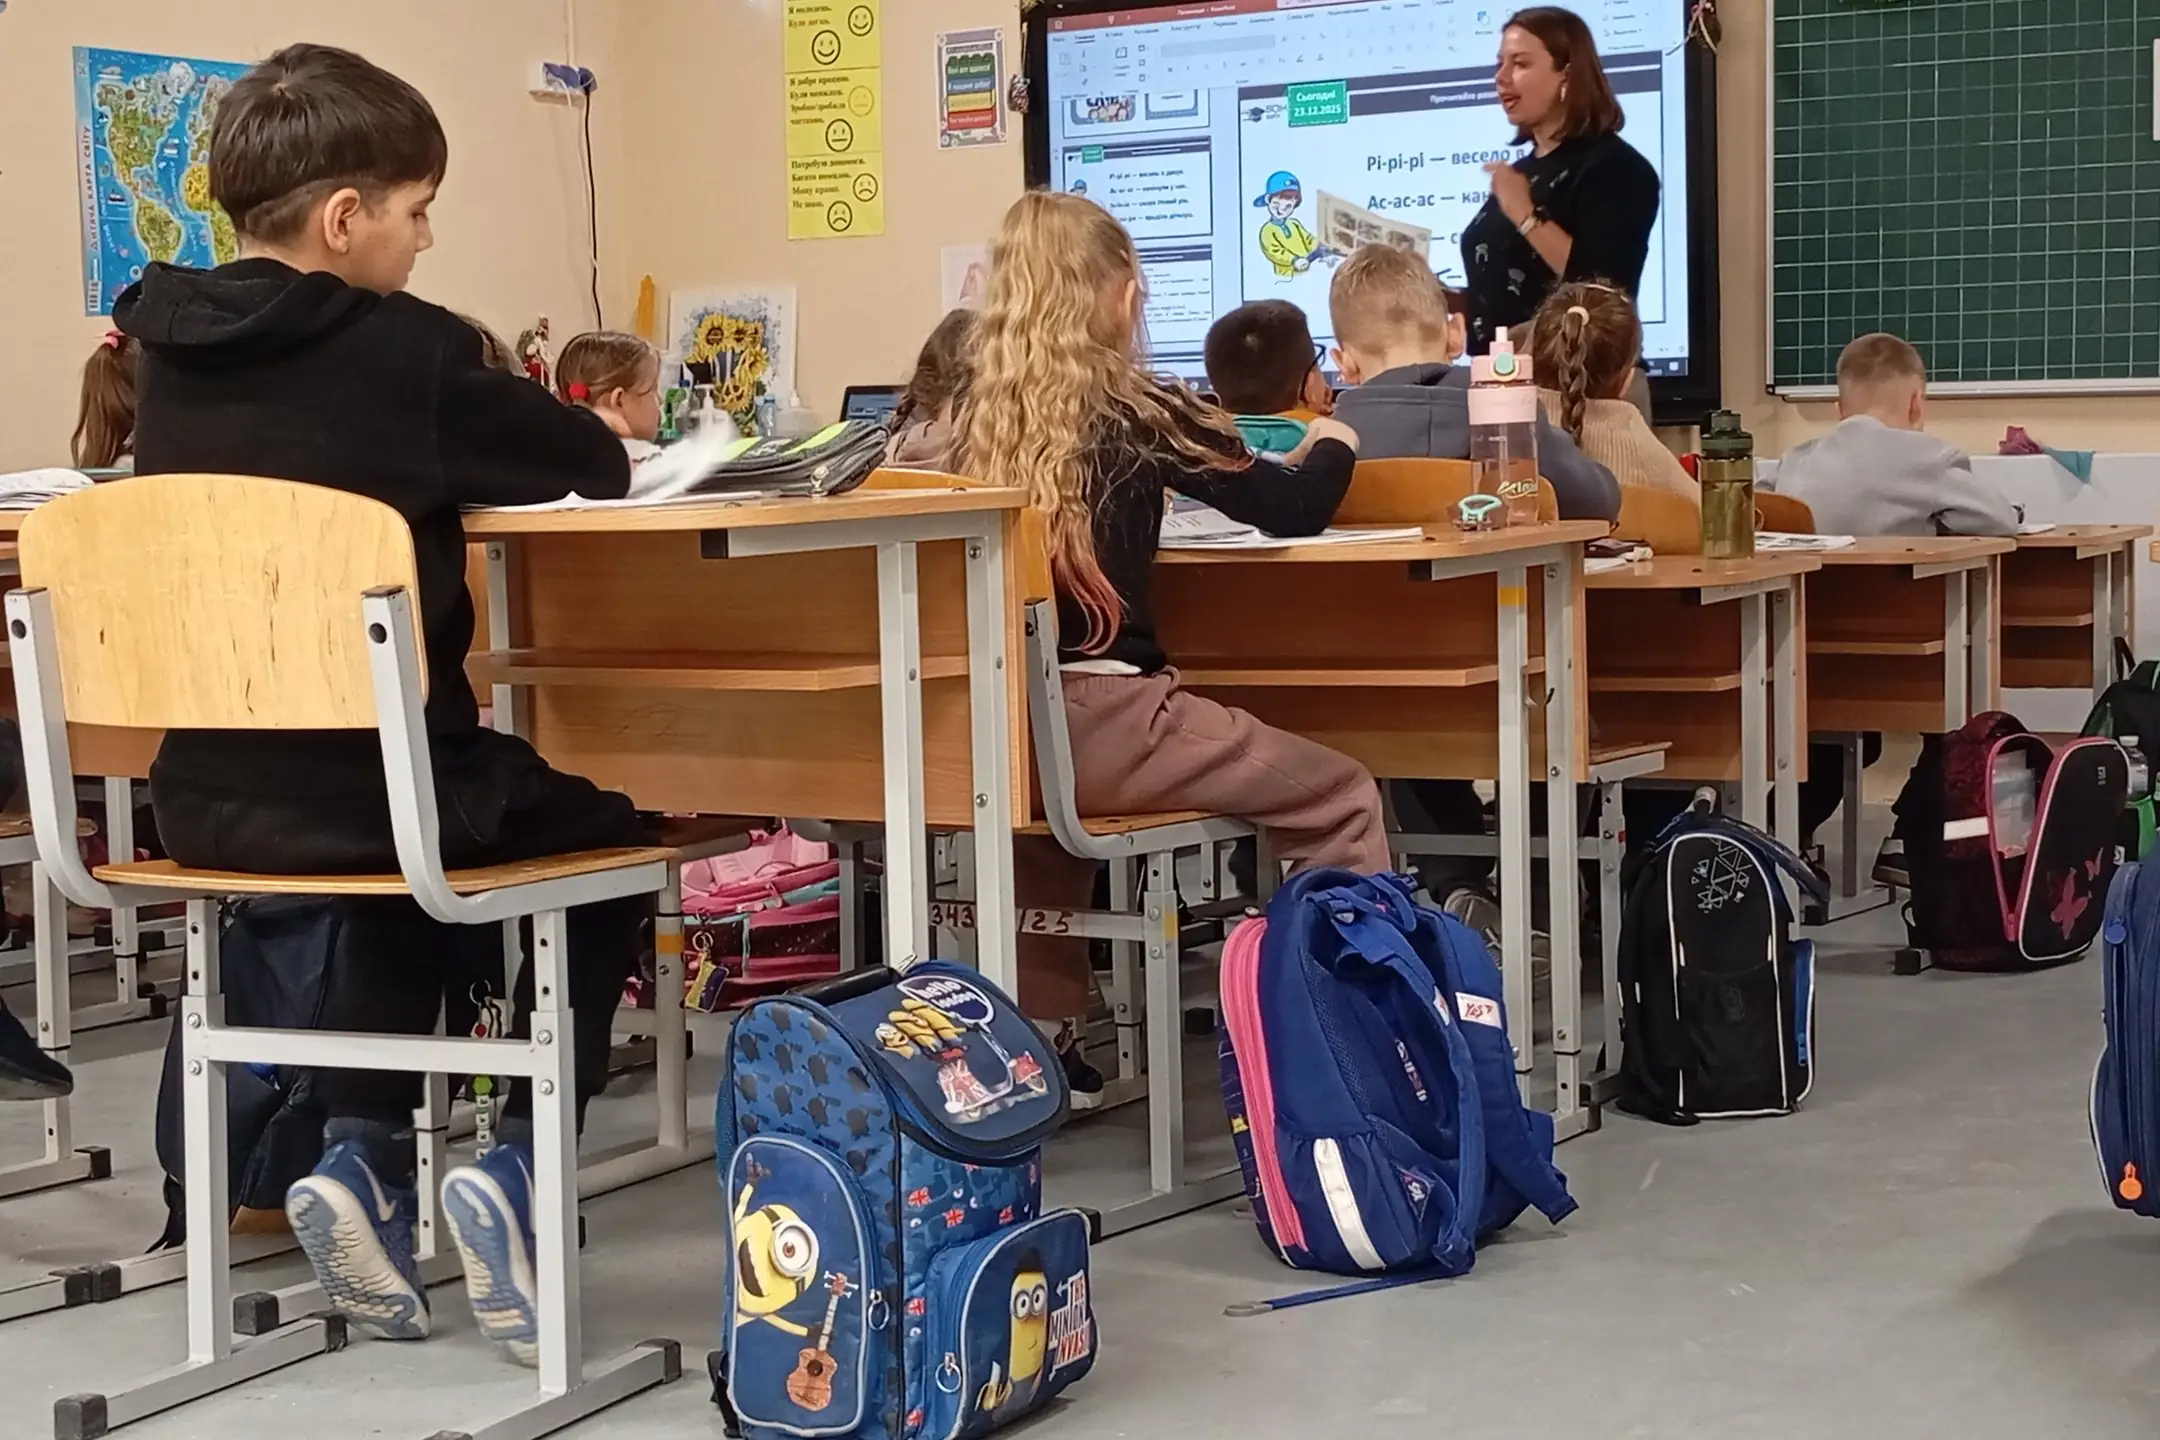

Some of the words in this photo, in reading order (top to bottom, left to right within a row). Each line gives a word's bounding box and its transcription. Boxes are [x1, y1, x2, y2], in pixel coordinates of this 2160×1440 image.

[1296, 90, 1336, 102] Сьогодні
[1367, 152, 1424, 173] Рі-рі-рі
[1451, 149, 1511, 165] весело
[1367, 194, 1435, 211] Ас-ас-ас
[1462, 190, 1490, 204] кан
[931, 904, 975, 928] 343
[906, 981, 962, 999] hello
